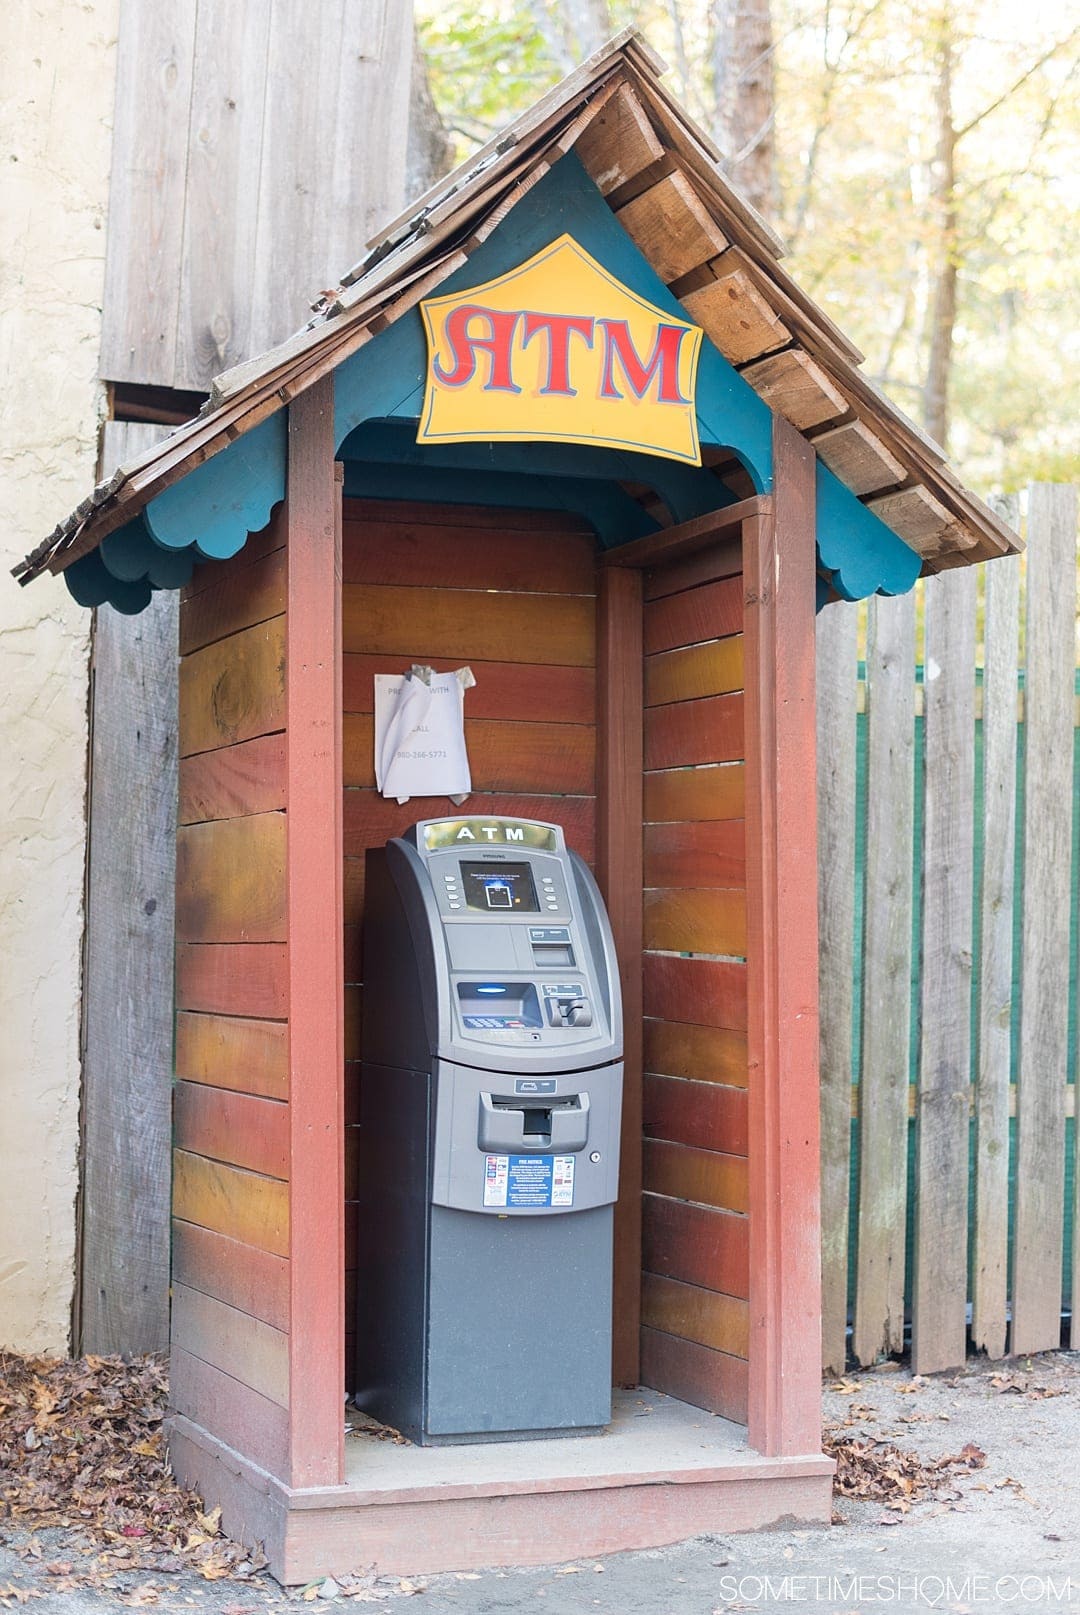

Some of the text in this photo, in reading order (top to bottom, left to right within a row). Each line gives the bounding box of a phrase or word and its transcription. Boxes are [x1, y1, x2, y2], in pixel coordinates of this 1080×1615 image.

[433, 304, 693, 404] ATM
[429, 686, 449, 695] WITH
[456, 826, 524, 841] ATM
